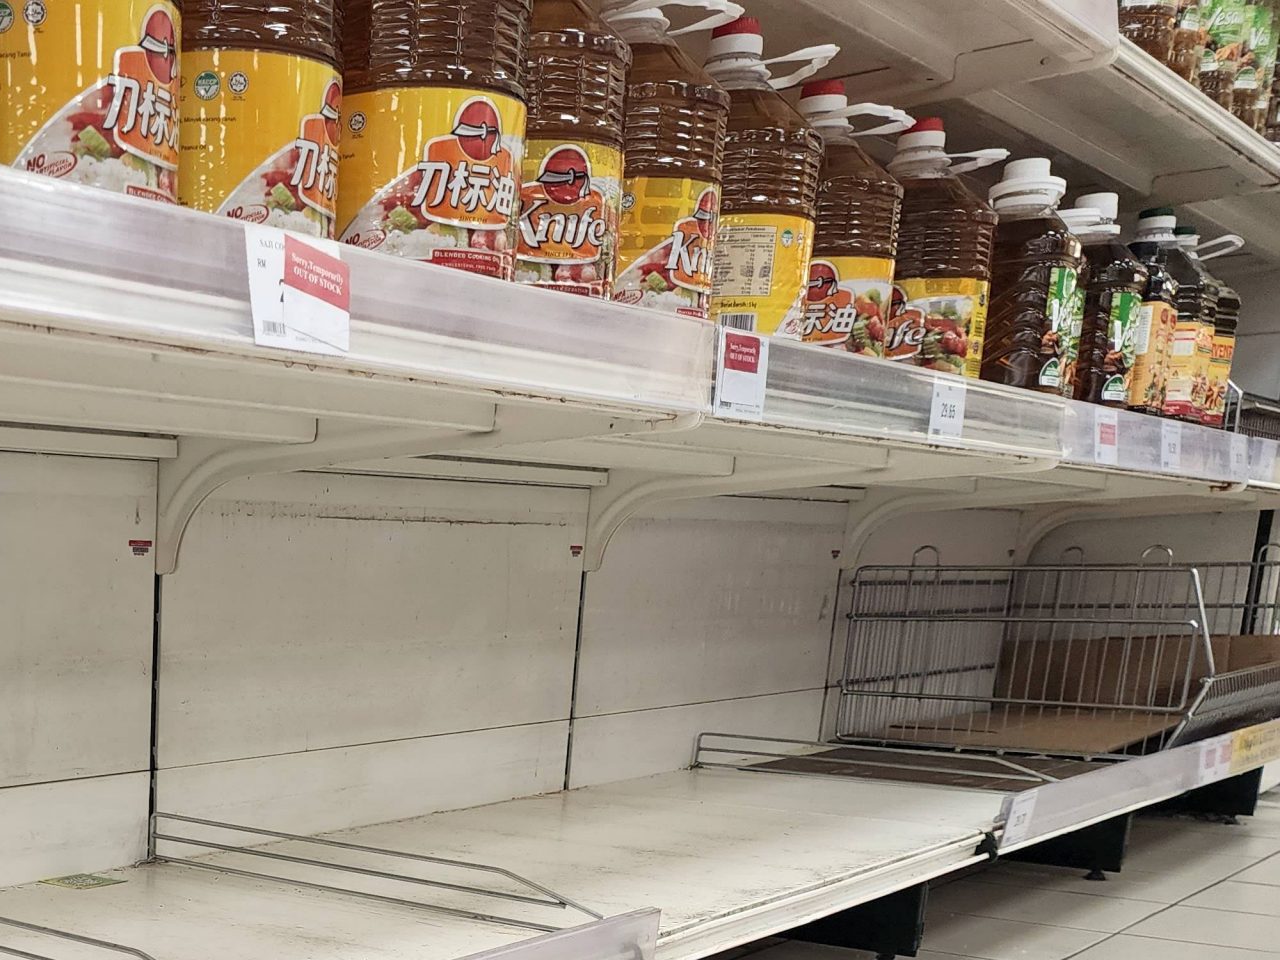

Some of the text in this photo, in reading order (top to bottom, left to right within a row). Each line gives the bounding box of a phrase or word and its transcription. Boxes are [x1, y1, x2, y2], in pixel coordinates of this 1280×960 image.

[26, 154, 45, 172] NO
[411, 161, 515, 217] 刀标油
[293, 266, 342, 296] OUT OF STOCK
